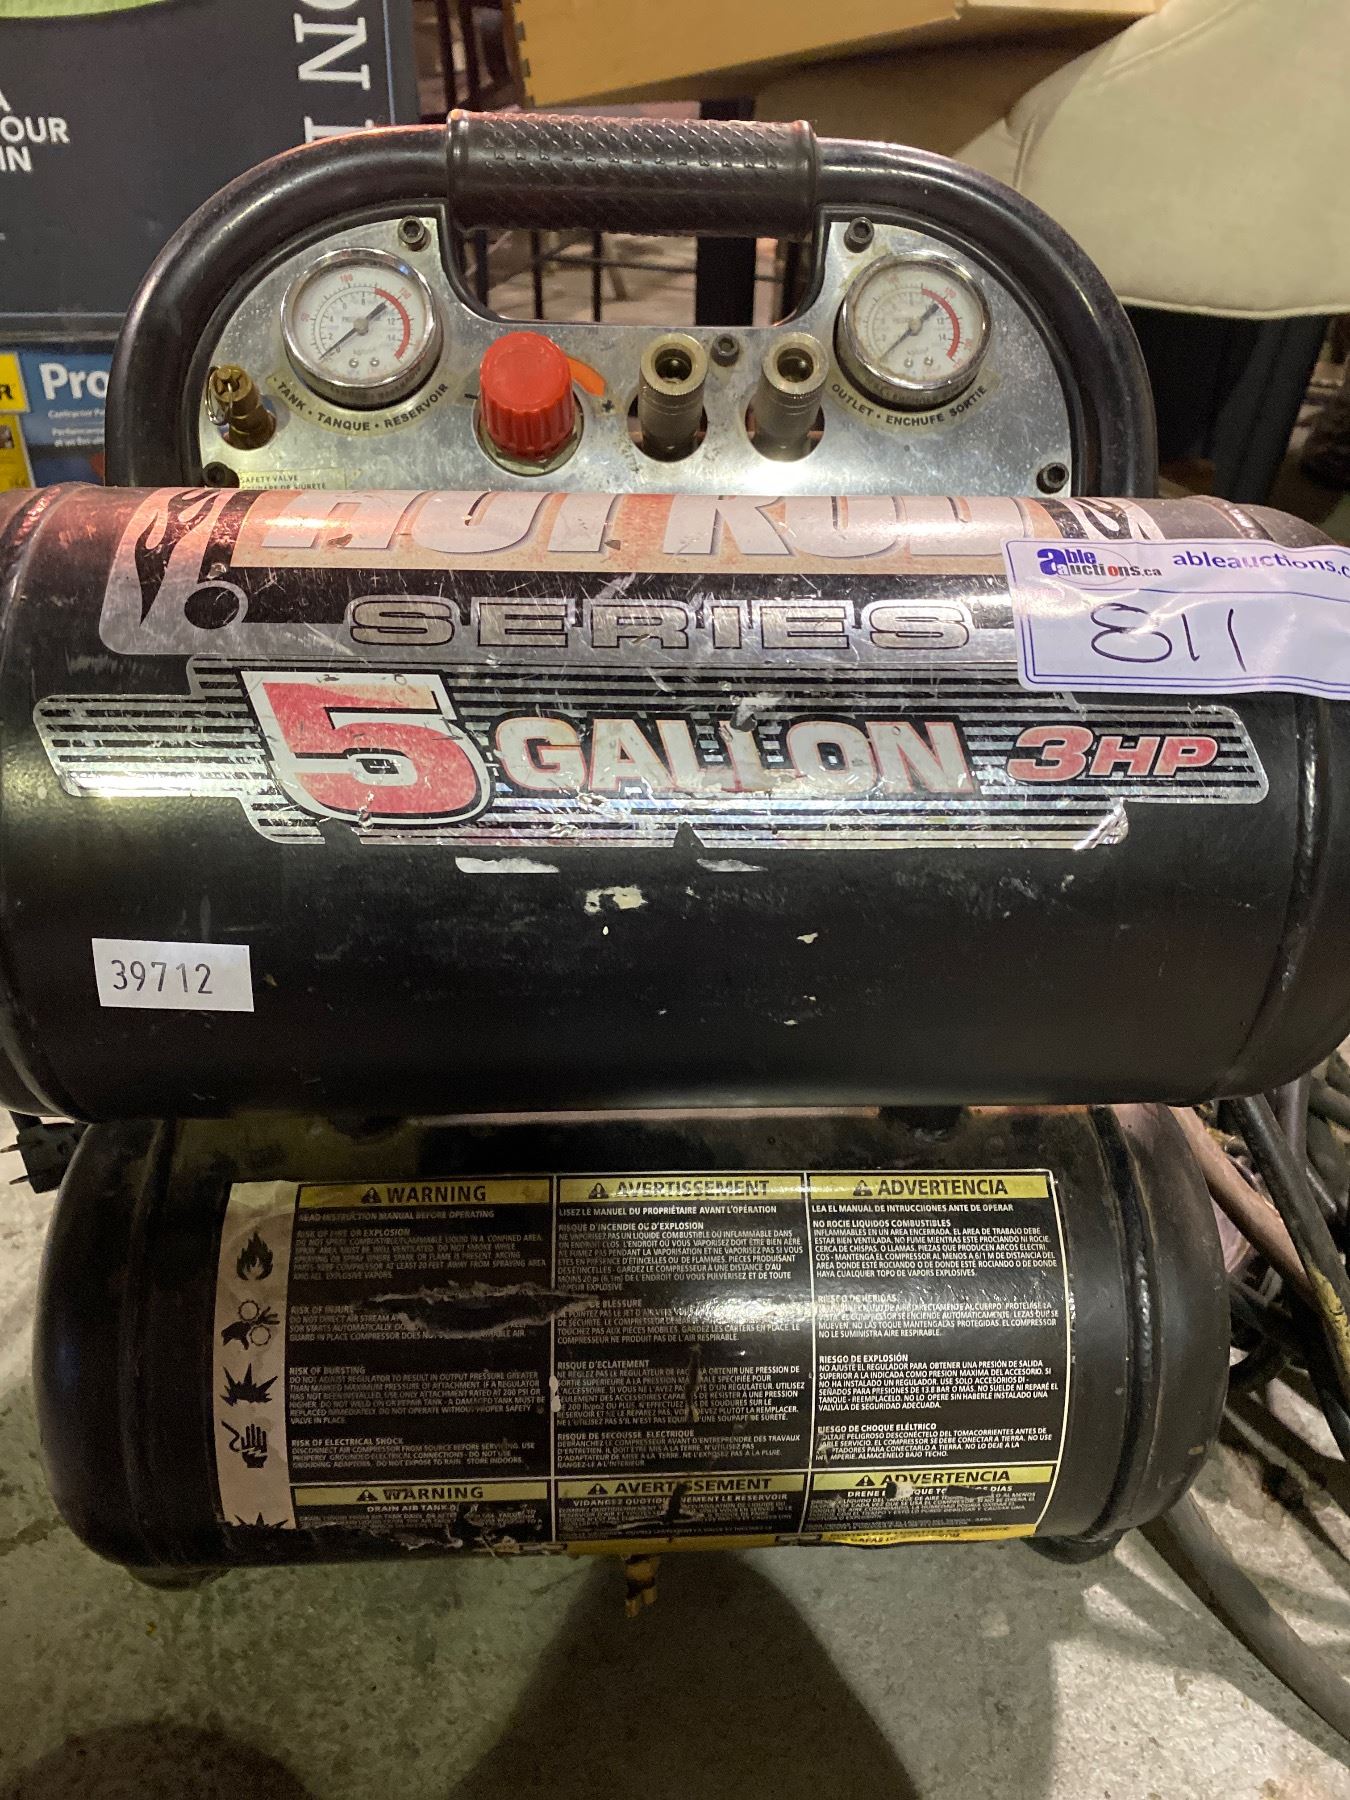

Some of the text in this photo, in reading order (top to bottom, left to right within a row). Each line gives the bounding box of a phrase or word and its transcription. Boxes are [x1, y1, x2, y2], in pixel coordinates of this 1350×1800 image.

[277, 382, 449, 432] TANK TANQUE RESERVOIR
[832, 383, 988, 427] OUTLET ENCHUFE SORTIE
[240, 474, 298, 484] SAFETY VALVE
[1037, 548, 1096, 575] able
[349, 600, 971, 650] SERIES
[241, 671, 1219, 825] 5 GALLON 3HP
[111, 959, 214, 995] 39712
[878, 1179, 1008, 1196] ADVERTENCIA
[387, 1184, 487, 1203] WARNING
[594, 1207, 627, 1215] MANUEL
[629, 1207, 640, 1215] DU
[643, 1206, 697, 1215] PROPRIÉTAIRE
[700, 1206, 725, 1214] AVANT
[875, 1204, 885, 1212] DE
[949, 1204, 968, 1212] ANTE
[970, 1204, 980, 1212] DE
[982, 1204, 1014, 1212] OPERAR
[651, 1222, 703, 1230] D'EXPLOSION
[813, 1220, 825, 1228] NO
[852, 1219, 889, 1227] LIQUIDOS
[891, 1219, 951, 1227] COMBUSTIBLES
[363, 1228, 410, 1237] EXPLOSION
[868, 1228, 877, 1236] EN
[879, 1228, 888, 1236] UN
[895, 1236, 905, 1244] NO
[907, 1236, 925, 1244] FUME
[1021, 1235, 1027, 1243] NI
[820, 1353, 908, 1364] RIESGO DE EXPLOSIÓN
[558, 1361, 586, 1369] RISQUE
[820, 1364, 830, 1372] NO
[858, 1363, 865, 1371] EL
[867, 1362, 908, 1371] REGULADOR
[910, 1362, 927, 1370] PARA
[930, 1361, 960, 1369] OBTENER
[962, 1361, 977, 1369] UNA
[979, 1360, 1007, 1368] PRESIÓN
[1009, 1360, 1017, 1368] DE
[1019, 1360, 1043, 1368] SALIDA
[310, 1367, 321, 1375] OF
[819, 1371, 852, 1380] SUPERIOR
[854, 1371, 859, 1379] A
[861, 1371, 868, 1379] LA
[871, 1370, 904, 1379] INDICADA
[906, 1370, 927, 1378] COMO
[819, 1380, 829, 1388] NO
[832, 1380, 841, 1388] HA
[844, 1379, 881, 1387] INSTALADO
[884, 1379, 894, 1387] UN
[975, 1376, 1017, 1385] ACCESORIOS
[818, 1425, 847, 1433] RIESGO
[848, 1424, 859, 1432] DE
[861, 1423, 894, 1432] CHOQUE
[291, 1439, 310, 1447] RISK
[325, 1438, 374, 1446] ELECTRICAL
[376, 1437, 403, 1445] SHOCK
[558, 1433, 586, 1442] RISQUE
[880, 1470, 1011, 1486] ADVERTENCIA
[614, 1478, 771, 1495] AVERTSSEMENT
[383, 1486, 484, 1501] WARNING
